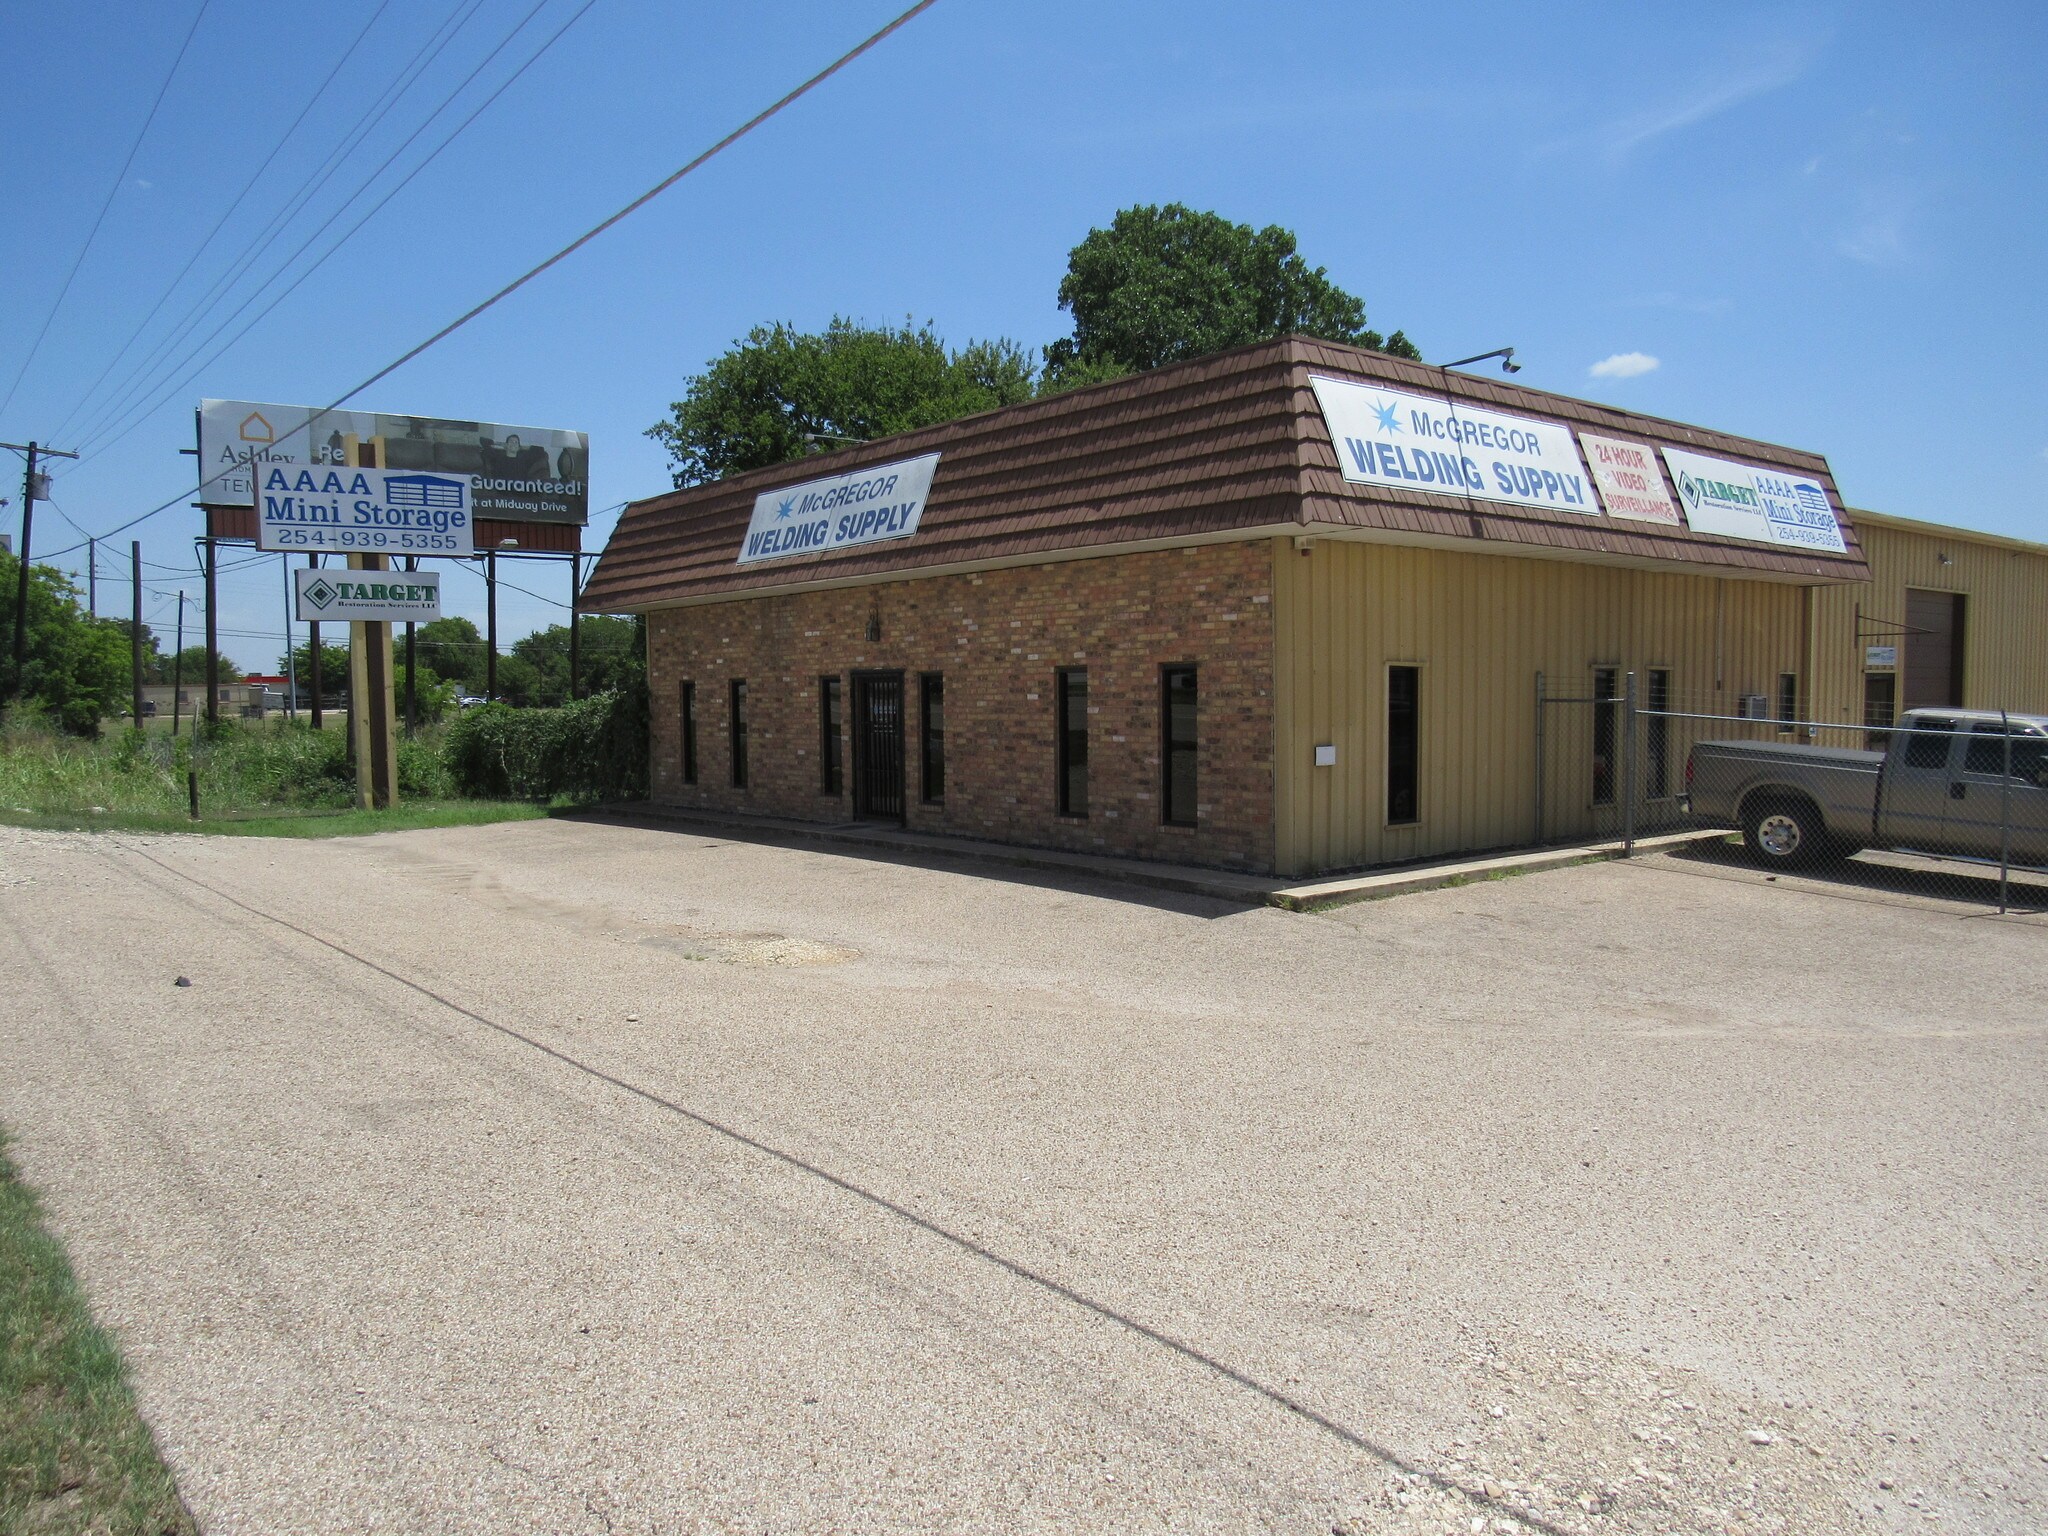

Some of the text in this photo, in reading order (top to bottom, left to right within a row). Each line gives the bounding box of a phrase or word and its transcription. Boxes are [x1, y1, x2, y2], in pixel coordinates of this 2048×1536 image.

[1410, 410, 1541, 456] McGREGOR
[1595, 444, 1647, 470] 24 HOUR
[264, 468, 373, 496] AAAA
[1345, 437, 1584, 505] WELDING SUPPLY
[1611, 470, 1647, 492] VIDEO
[471, 474, 581, 496] Guaranteed!
[798, 474, 898, 515] McGREGOR
[1695, 478, 1758, 507] TARGET
[1755, 476, 1795, 499] AAAA
[264, 496, 466, 533] Mini Storage
[481, 499, 493, 508] at
[496, 499, 538, 513] Midway
[541, 502, 567, 512] Drive
[1605, 493, 1674, 517] SURVEILLANCE
[1761, 498, 1836, 532] Mini Storage
[278, 529, 457, 549] 254-939-5355
[747, 502, 916, 556] WELDING SUPPLY
[1777, 526, 1840, 547] 254-939-5355
[336, 583, 437, 601] TARGET
